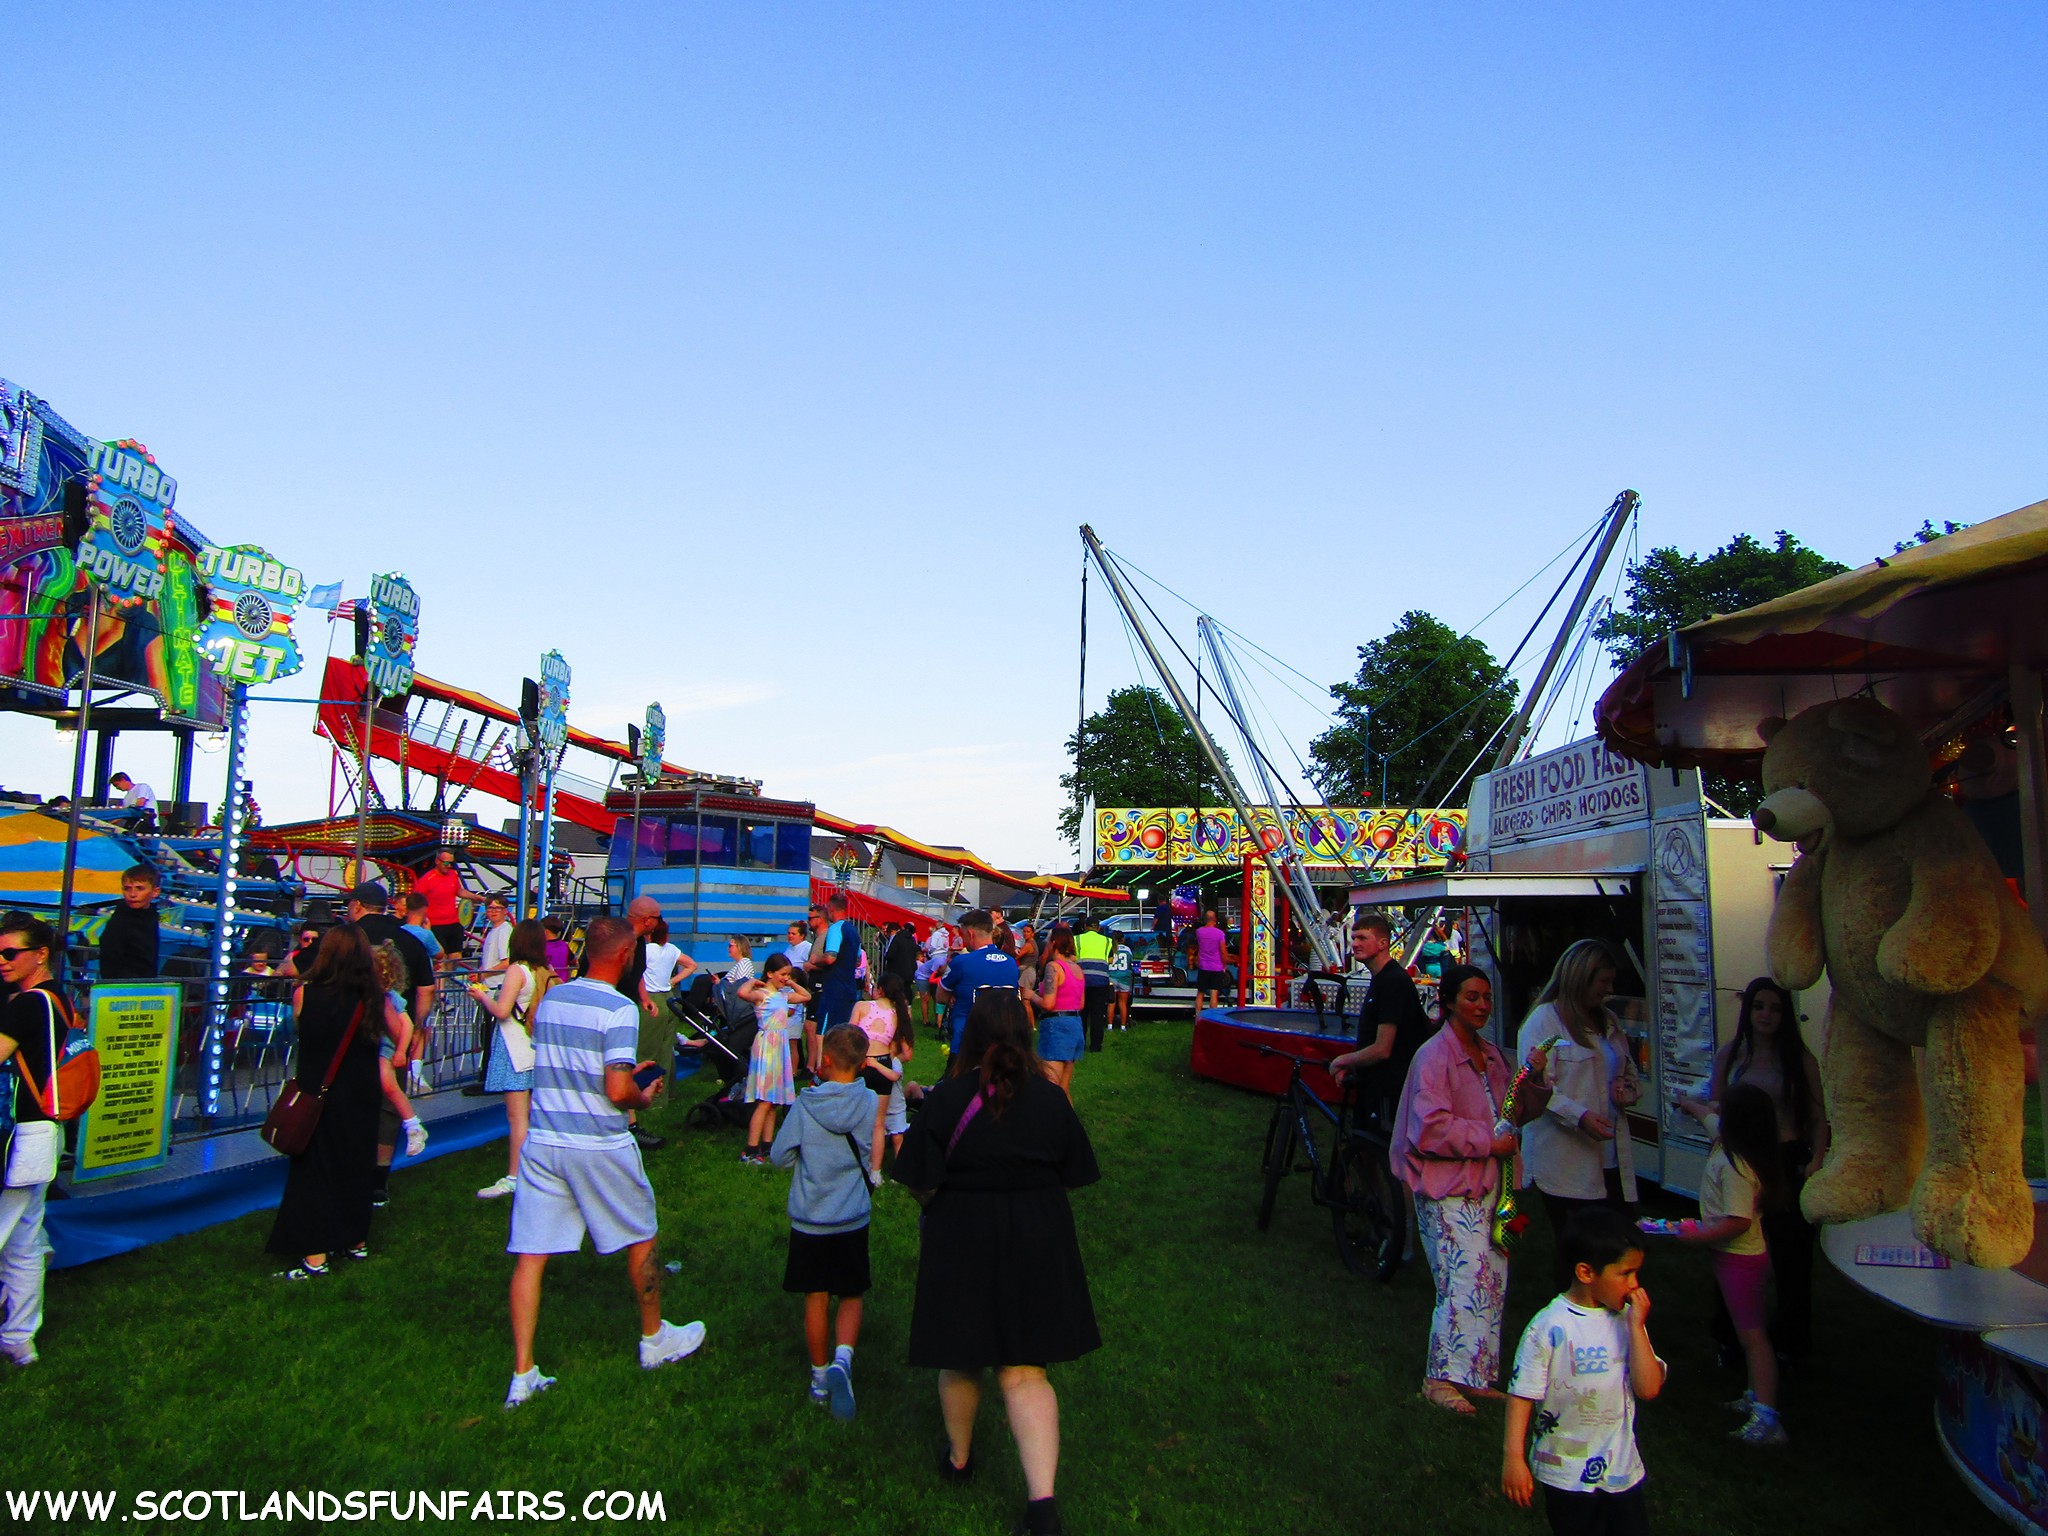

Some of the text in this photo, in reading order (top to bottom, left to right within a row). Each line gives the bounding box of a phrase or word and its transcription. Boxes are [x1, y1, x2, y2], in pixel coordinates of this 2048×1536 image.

[87, 436, 177, 506] TURBO
[76, 541, 165, 600] POWER
[202, 545, 301, 597] TURBO
[371, 573, 420, 619] TURBO
[168, 552, 194, 706] ULTIMATE
[212, 639, 286, 682] JET
[367, 653, 413, 696] TIME
[541, 653, 571, 686] TURBO
[538, 717, 568, 748] TIME
[1494, 769, 1536, 809] FRESH
[1540, 752, 1585, 796] FOOD
[1541, 799, 1572, 826] CHIPS
[1579, 782, 1640, 817] HOTDOGS
